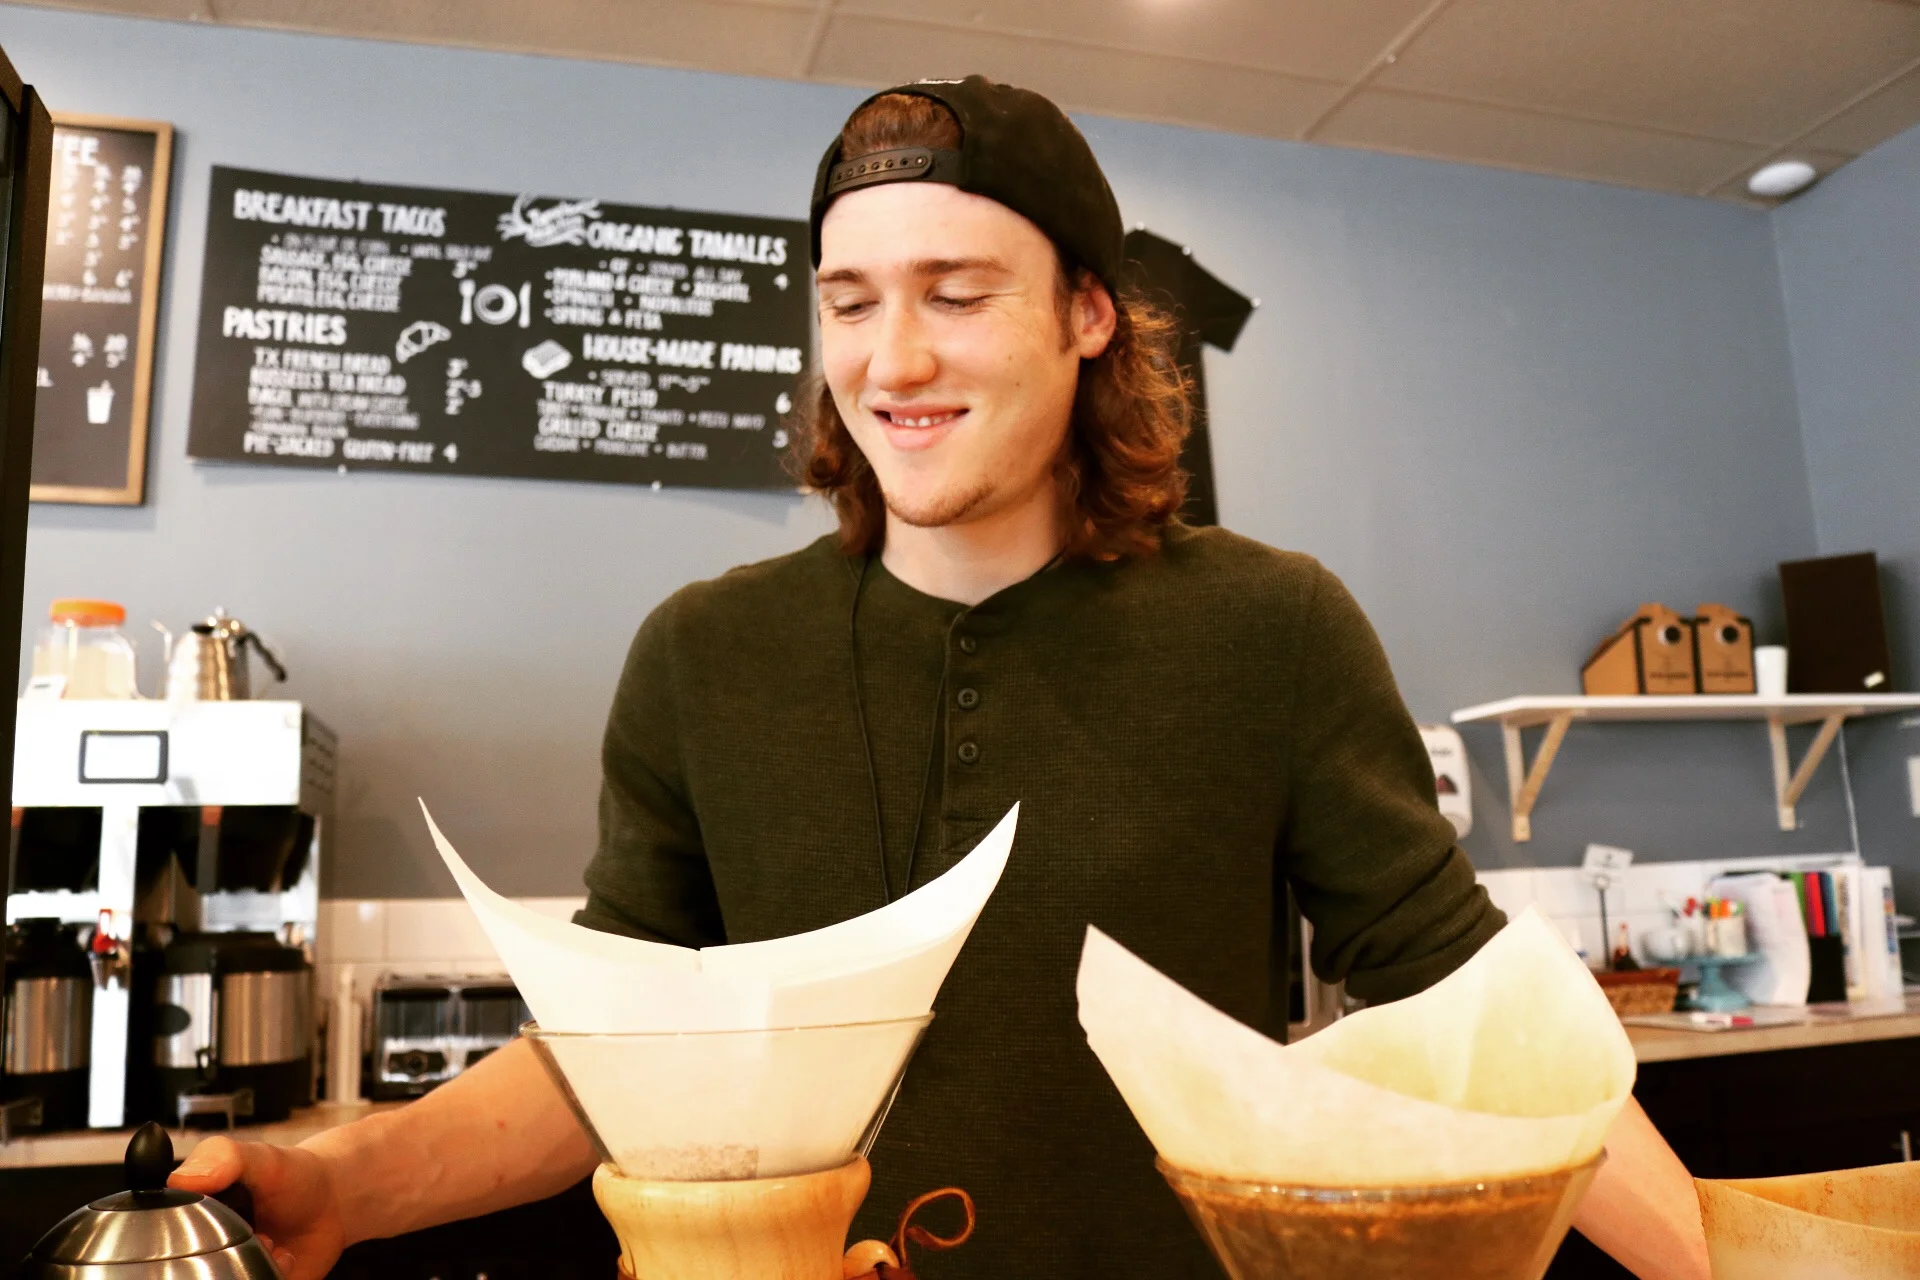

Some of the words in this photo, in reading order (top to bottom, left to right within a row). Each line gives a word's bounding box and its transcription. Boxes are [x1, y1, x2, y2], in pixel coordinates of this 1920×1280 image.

[233, 188, 373, 231] BREAKFAST
[378, 203, 447, 237] TACOS
[587, 221, 684, 256] ORGANIC
[688, 229, 787, 266] TAMALES
[222, 306, 347, 345] PASTRIES
[583, 333, 716, 369] HOUSE-MADE
[775, 391, 791, 414] 6
